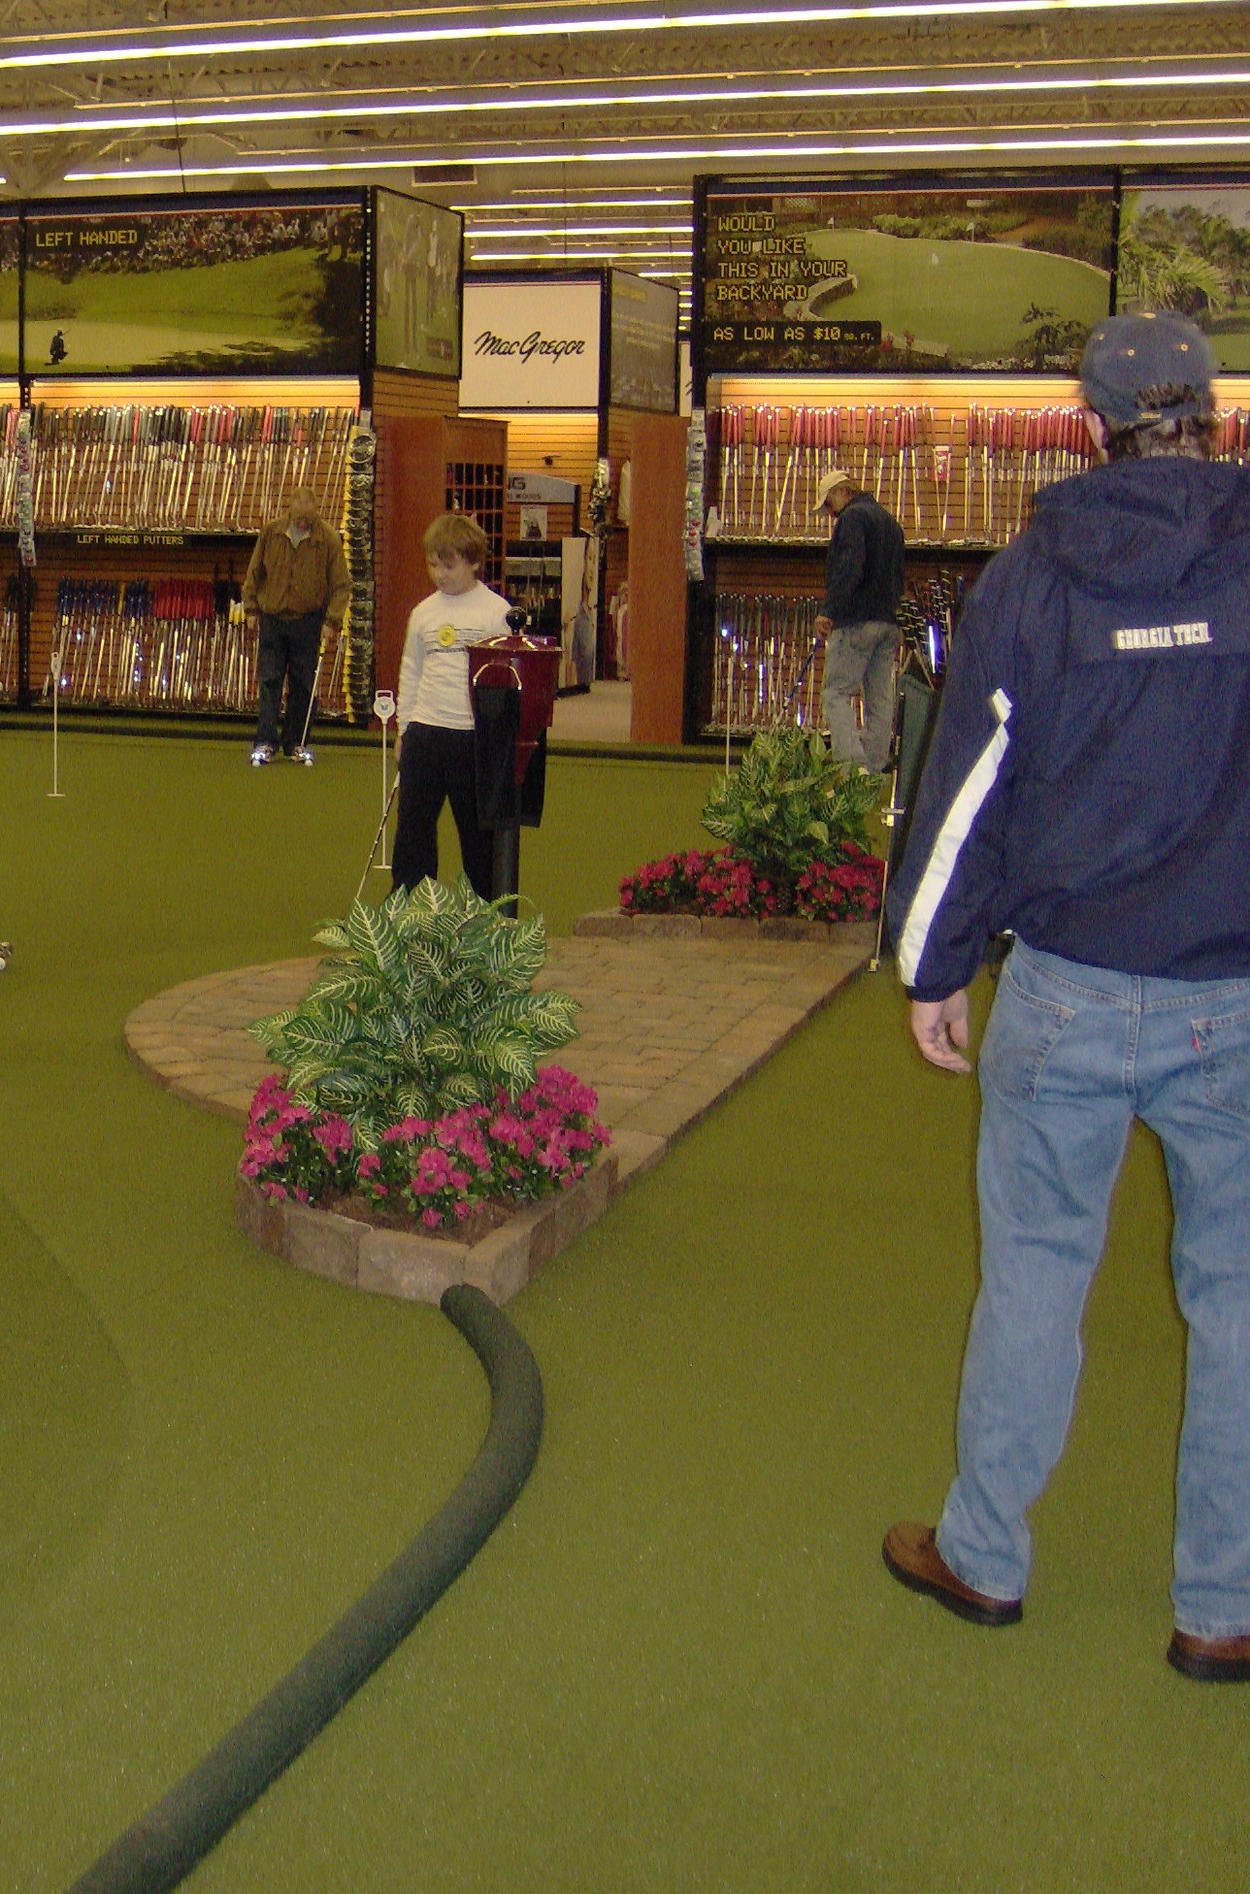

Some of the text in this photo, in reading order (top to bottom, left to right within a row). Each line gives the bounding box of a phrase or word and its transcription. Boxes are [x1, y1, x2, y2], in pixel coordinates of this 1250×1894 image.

[717, 216, 776, 232] WOULD
[36, 230, 138, 247] LEFT HANDED
[717, 238, 805, 254] YOU LIKE
[717, 261, 847, 277] THIS IN YOUR
[717, 284, 808, 300] BACKYARD
[713, 327, 734, 341] AS
[743, 327, 775, 341] LOW
[784, 327, 805, 341] AS
[814, 326, 841, 341] $10
[860, 332, 875, 341] FT.
[474, 331, 586, 364] MacGregor
[77, 535, 184, 545] LEFT HANDED PUTTERS
